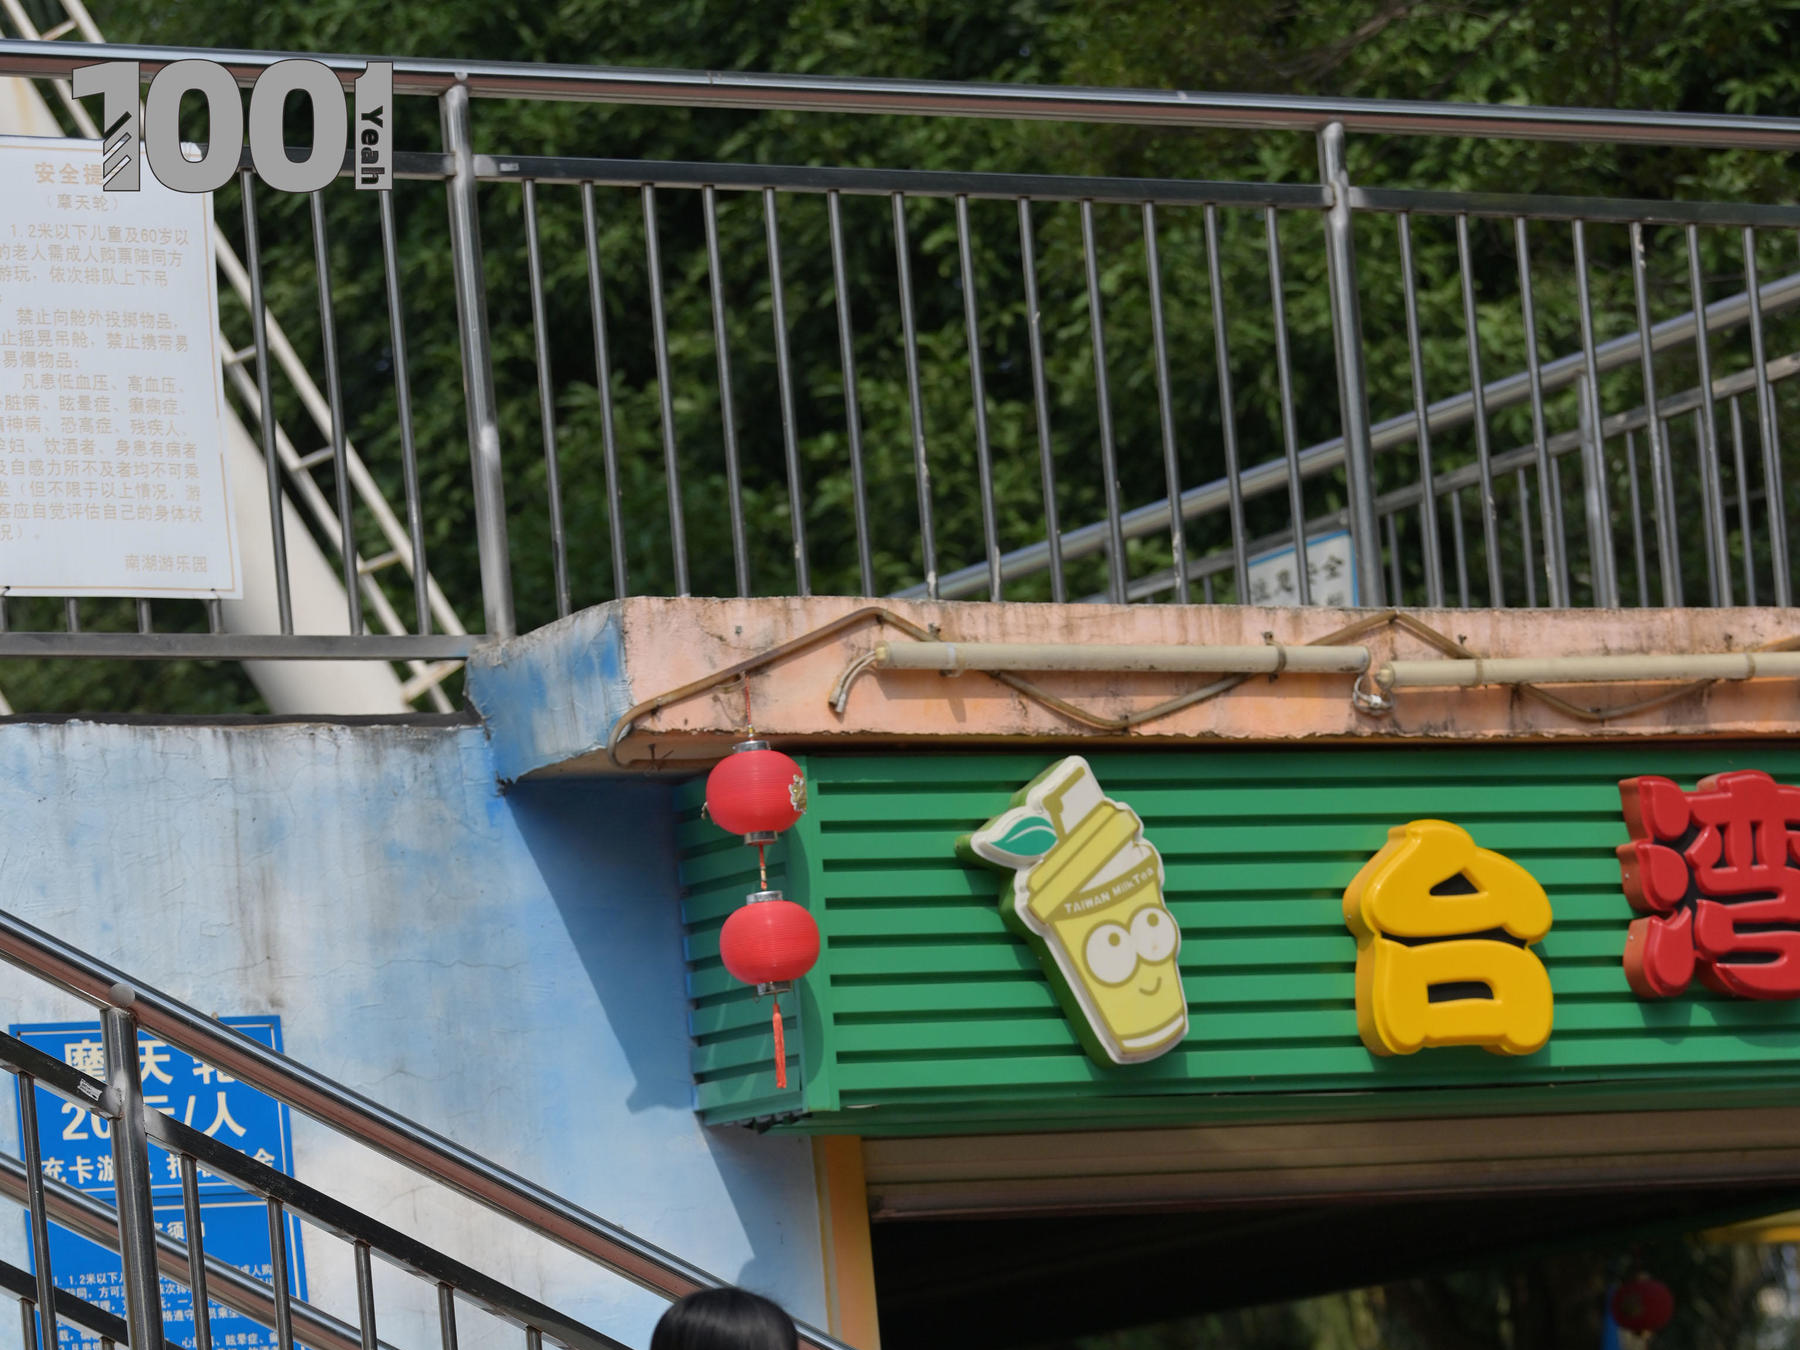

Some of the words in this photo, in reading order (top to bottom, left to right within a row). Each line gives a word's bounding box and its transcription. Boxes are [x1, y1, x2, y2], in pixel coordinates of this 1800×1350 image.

[34, 161, 104, 186] 安全提
[0, 394, 186, 416] 脏病、眩晕症、癫痫症、
[1063, 890, 1111, 915] TAIWAN
